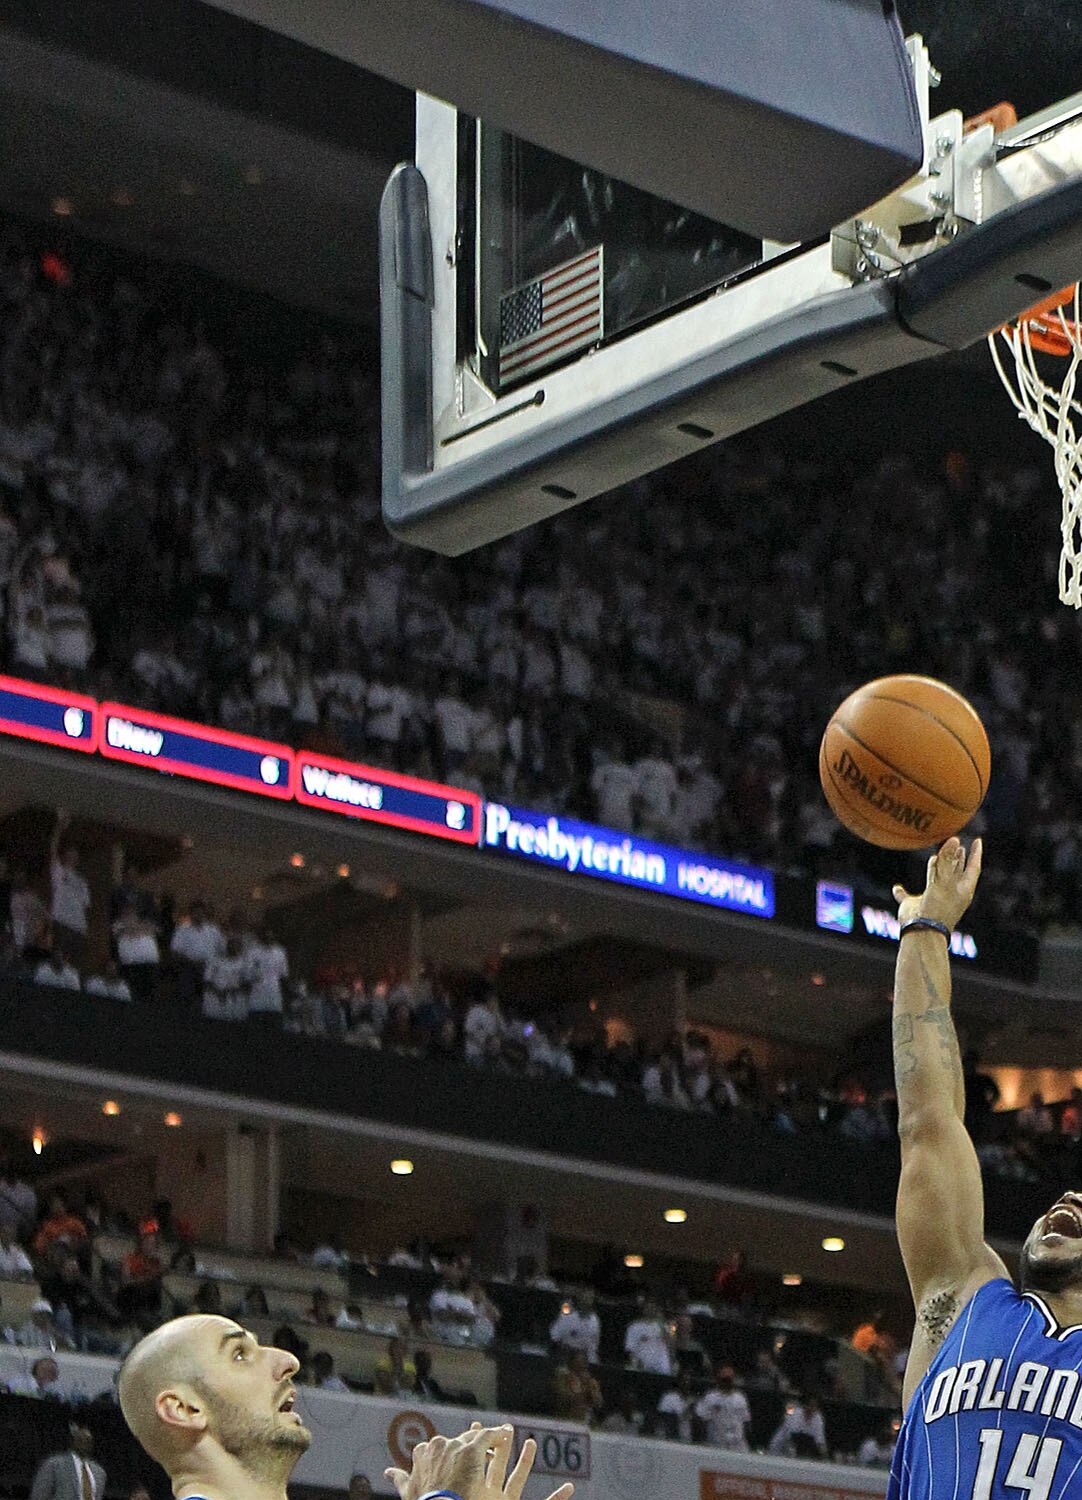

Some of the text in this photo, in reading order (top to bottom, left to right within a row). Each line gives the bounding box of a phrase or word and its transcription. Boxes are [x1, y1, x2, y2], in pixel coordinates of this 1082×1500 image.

[302, 765, 383, 810] Wallace
[833, 748, 937, 833] SPALDING
[486, 803, 769, 909] Presbyterian HOSPITAL
